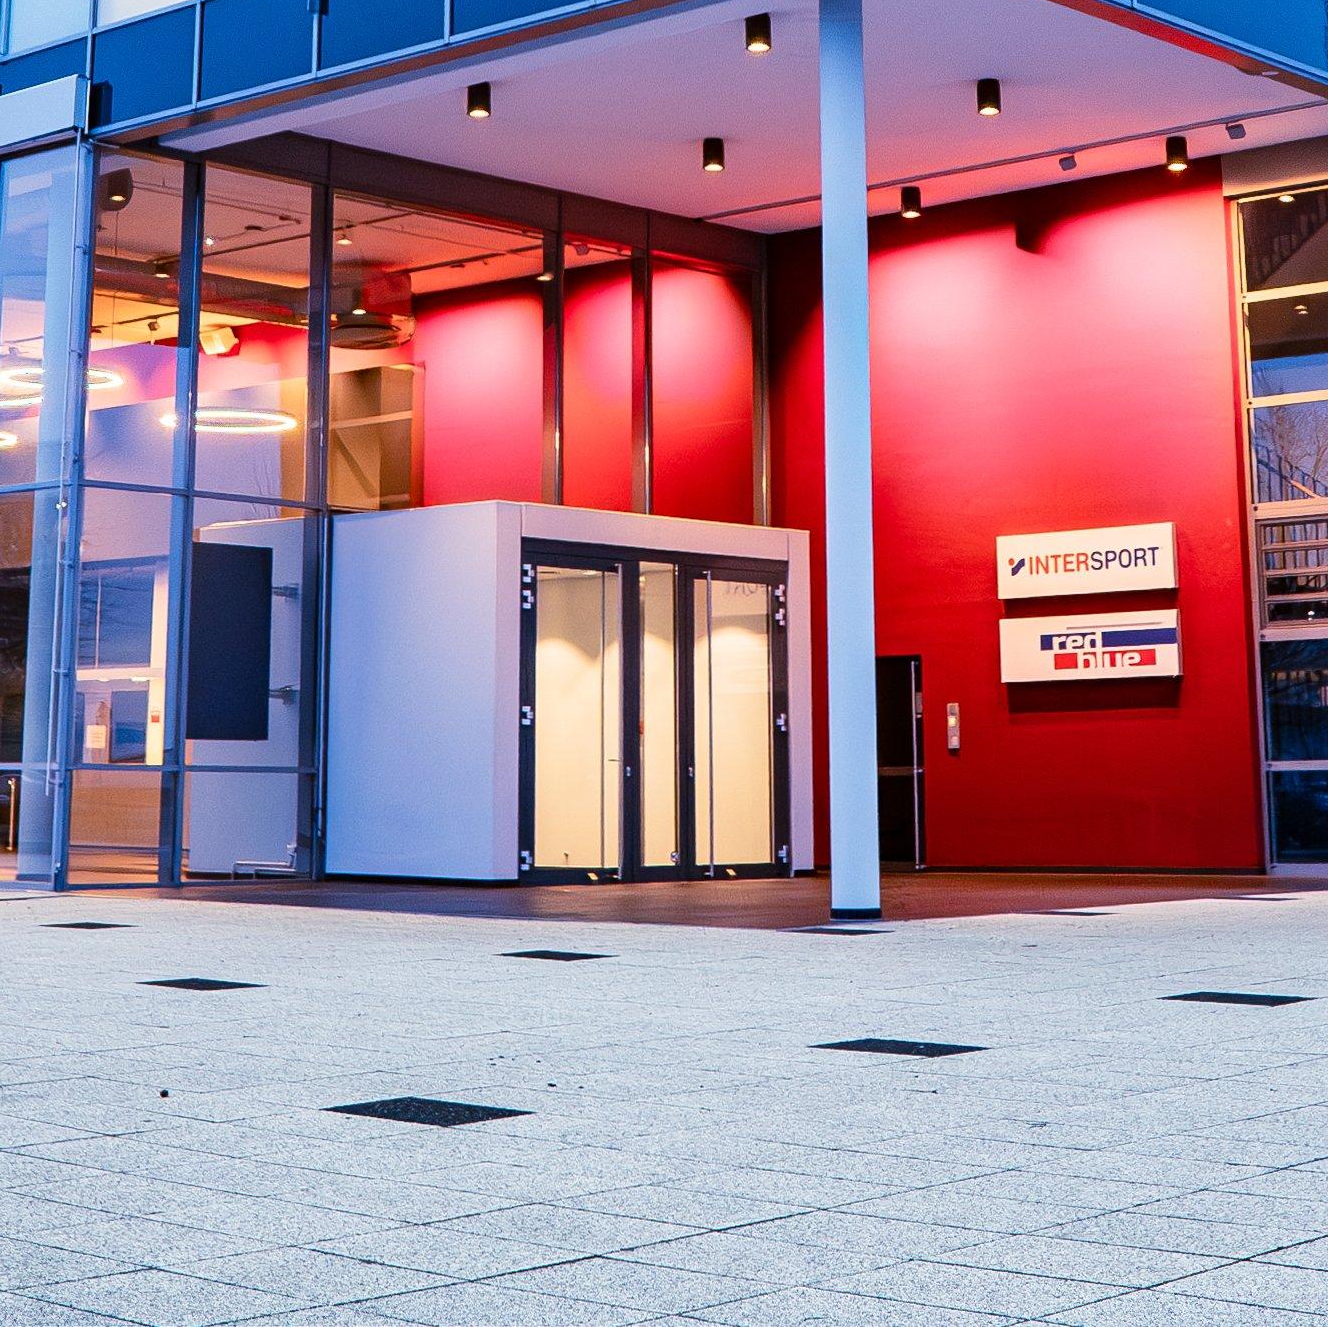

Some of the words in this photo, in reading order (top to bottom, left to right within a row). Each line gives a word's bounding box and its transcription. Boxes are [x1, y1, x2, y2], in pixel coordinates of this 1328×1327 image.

[1028, 546, 1160, 576] INTERSPORT
[1052, 631, 1102, 650] red
[1077, 650, 1143, 669] blue
